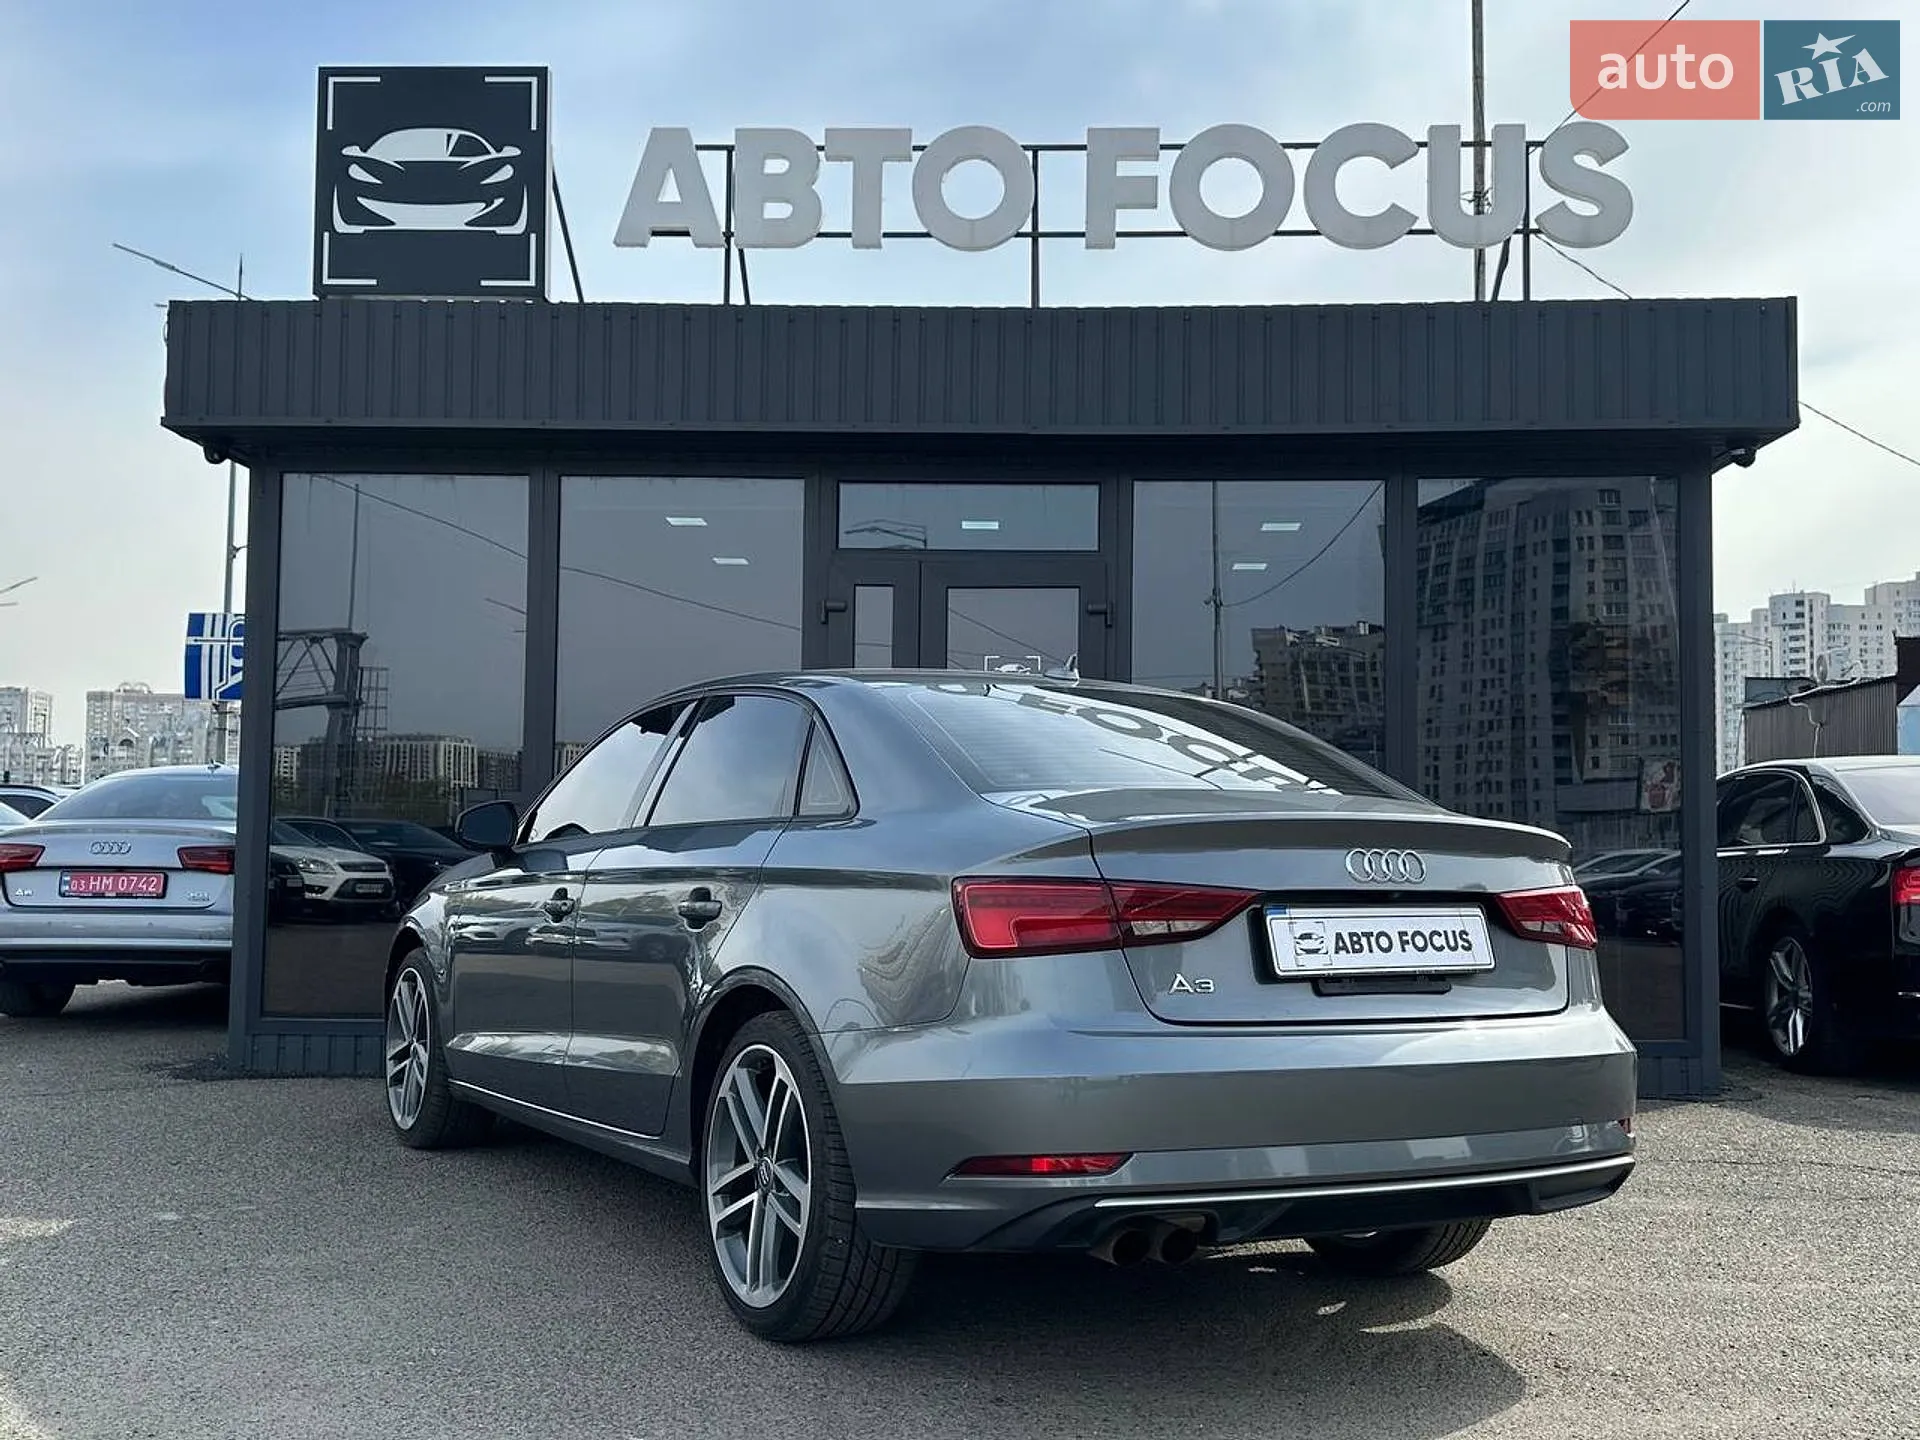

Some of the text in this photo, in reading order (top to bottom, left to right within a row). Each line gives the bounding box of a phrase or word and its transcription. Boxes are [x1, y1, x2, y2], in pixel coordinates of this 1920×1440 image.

[1084, 122, 1634, 252] FOCUS
[88, 876, 113, 891] HM
[118, 876, 157, 891] 0742
[1397, 928, 1473, 953] FOCUS
[1168, 973, 1215, 994] A3
